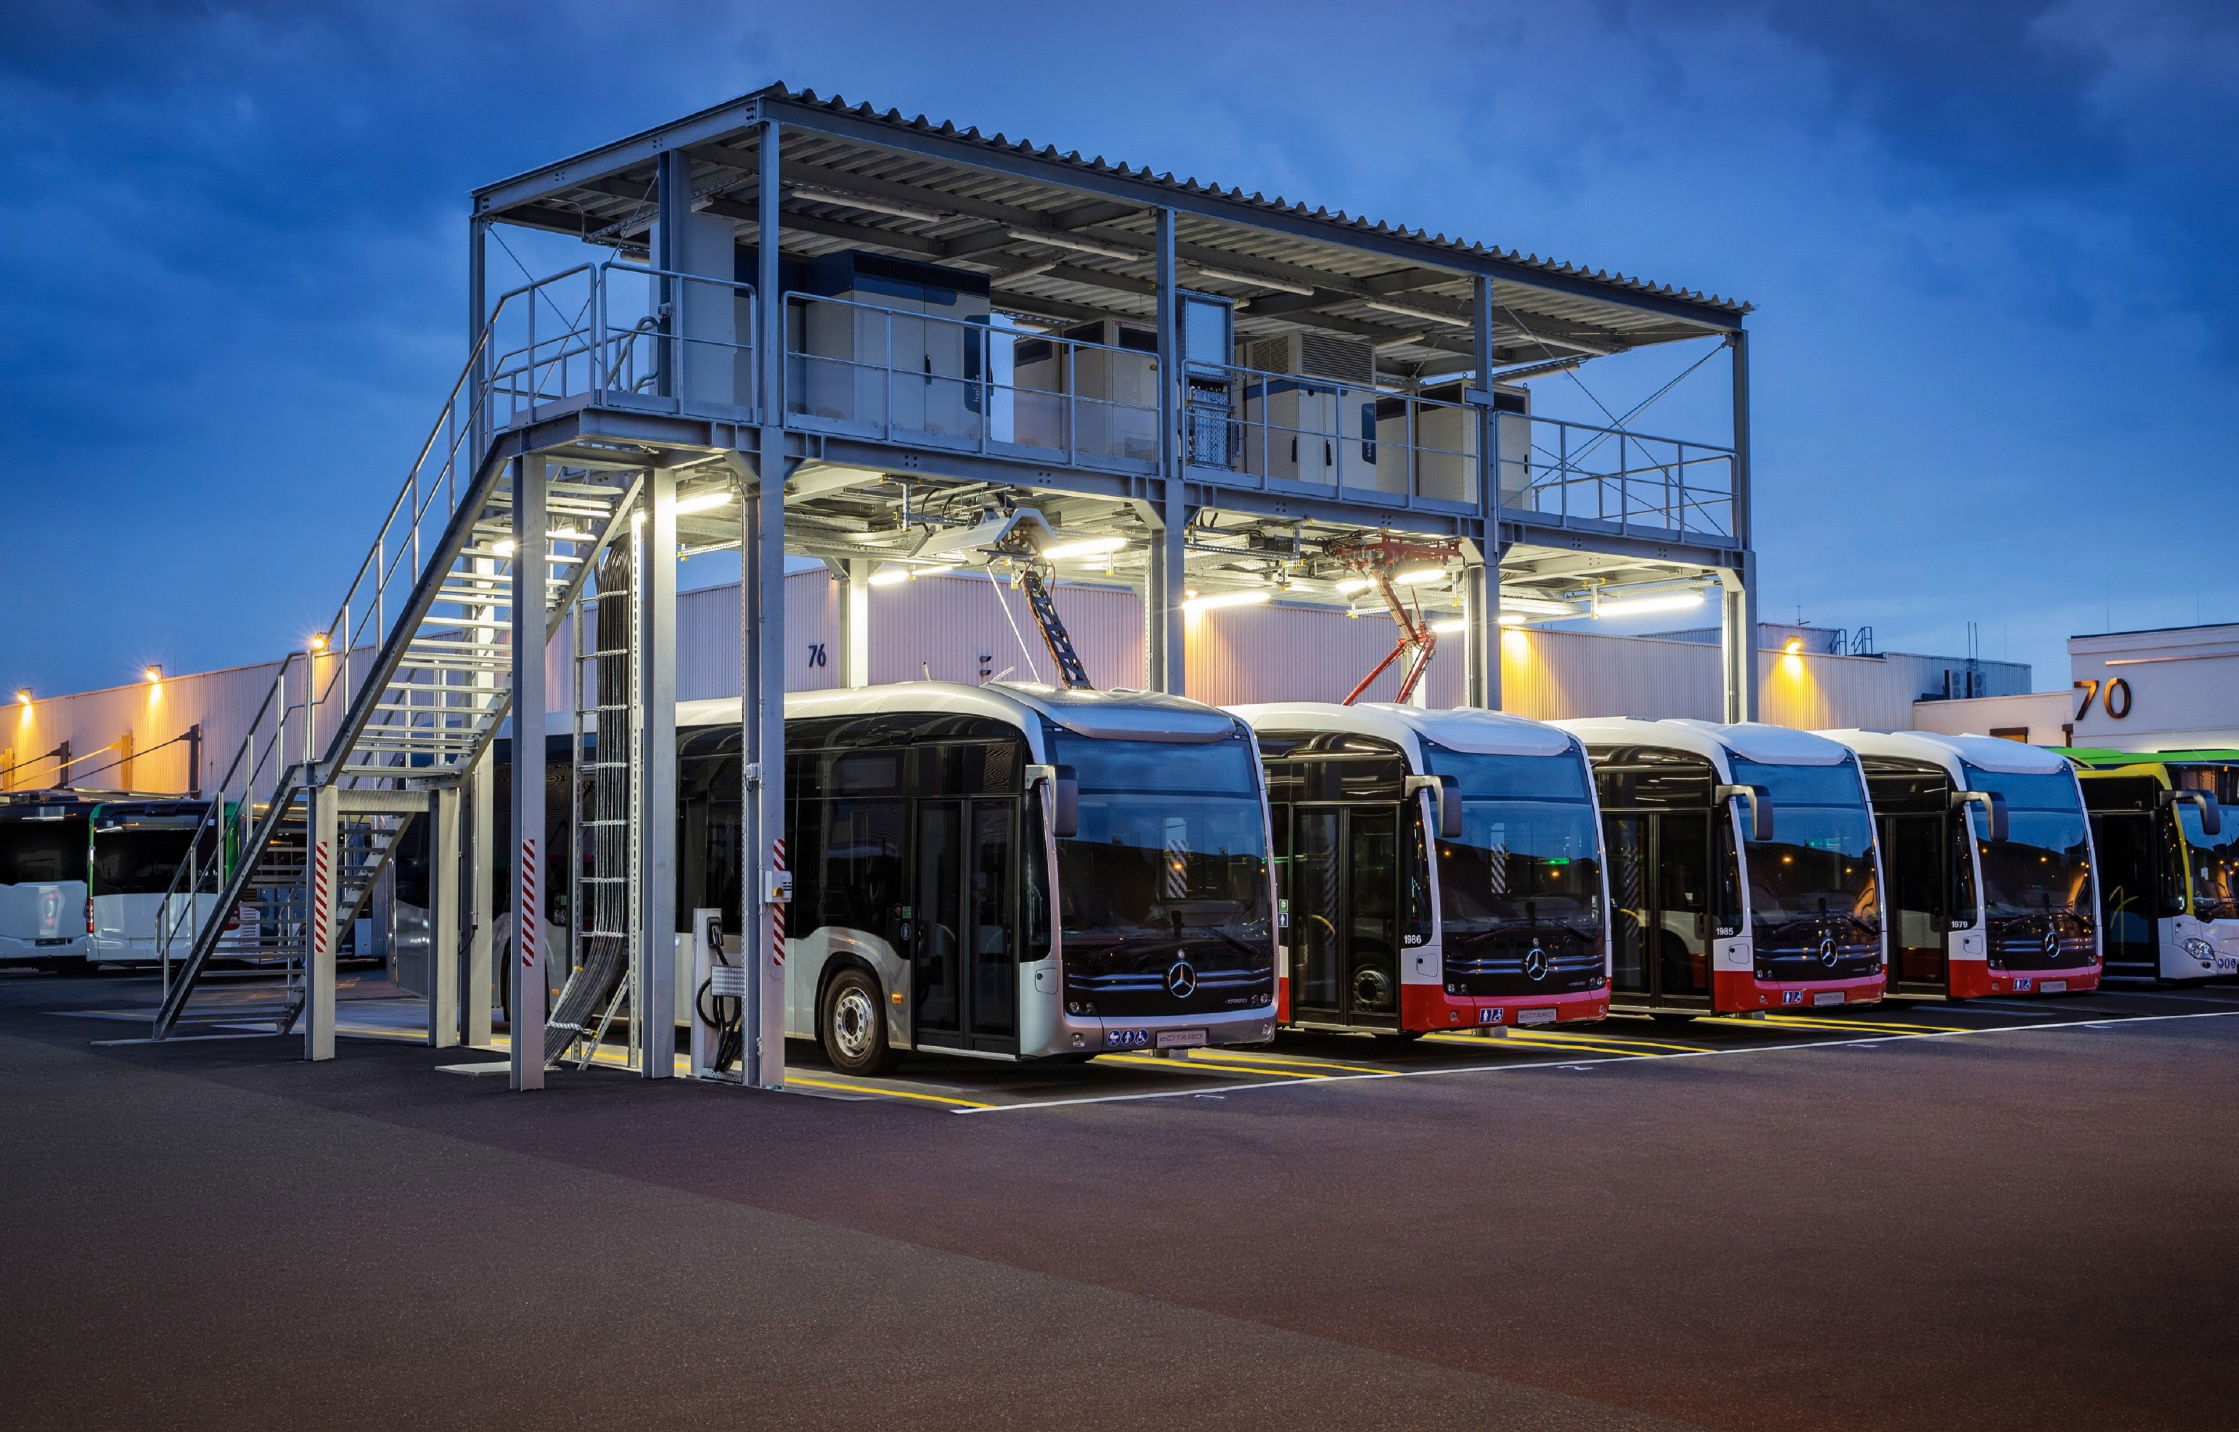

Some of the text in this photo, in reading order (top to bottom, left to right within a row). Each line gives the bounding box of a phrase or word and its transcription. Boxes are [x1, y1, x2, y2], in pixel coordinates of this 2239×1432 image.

[808, 644, 826, 667] 76
[2074, 678, 2131, 720] 70
[1951, 920, 1968, 928] 1979
[1716, 927, 1733, 936] 1985
[1404, 935, 1421, 944] 1986
